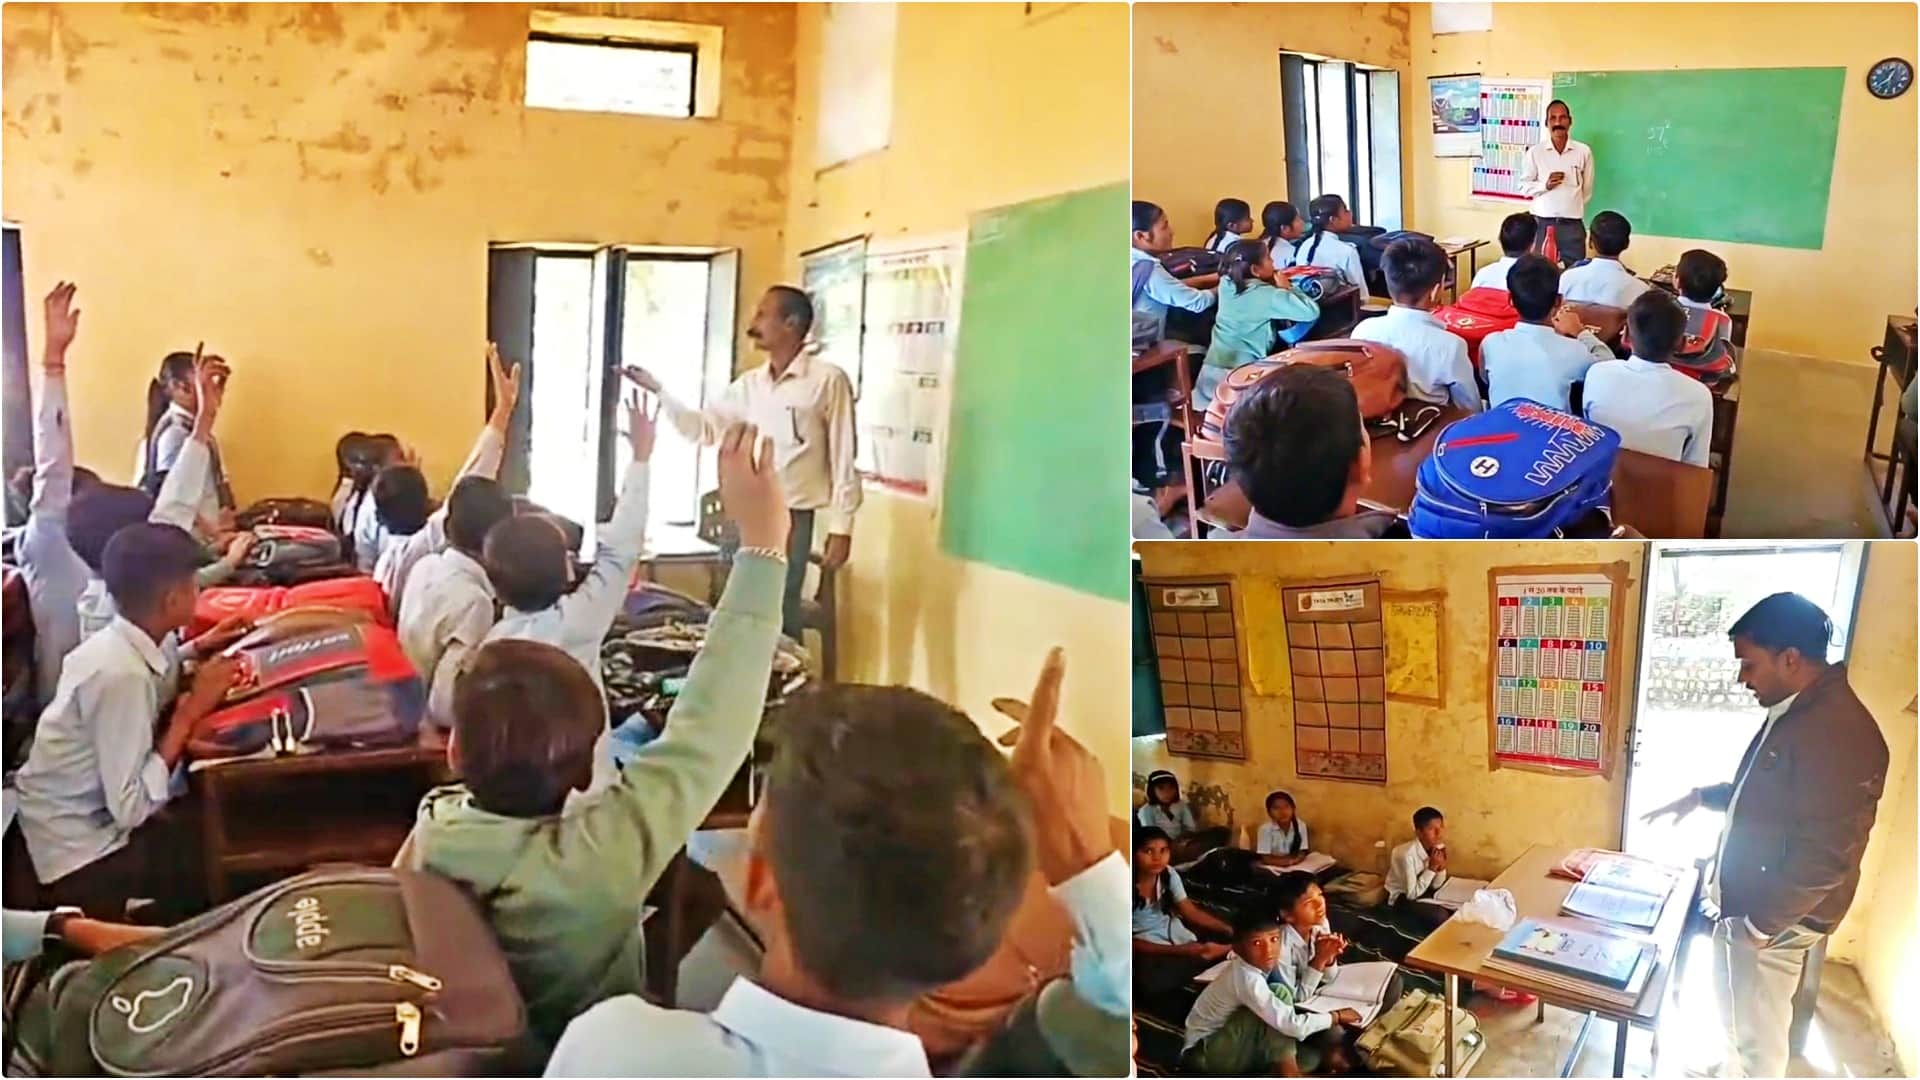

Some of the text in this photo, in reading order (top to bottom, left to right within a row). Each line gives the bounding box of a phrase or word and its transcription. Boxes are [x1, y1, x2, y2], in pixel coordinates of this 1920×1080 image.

[1547, 640, 1553, 648] 8
[1569, 641, 1577, 649] 9
[1589, 642, 1603, 650] 10
[1502, 679, 1512, 687] 11
[1587, 683, 1599, 691] 15
[1520, 719, 1532, 727] 17
[1541, 720, 1553, 728] 18
[287, 897, 331, 950] apple
